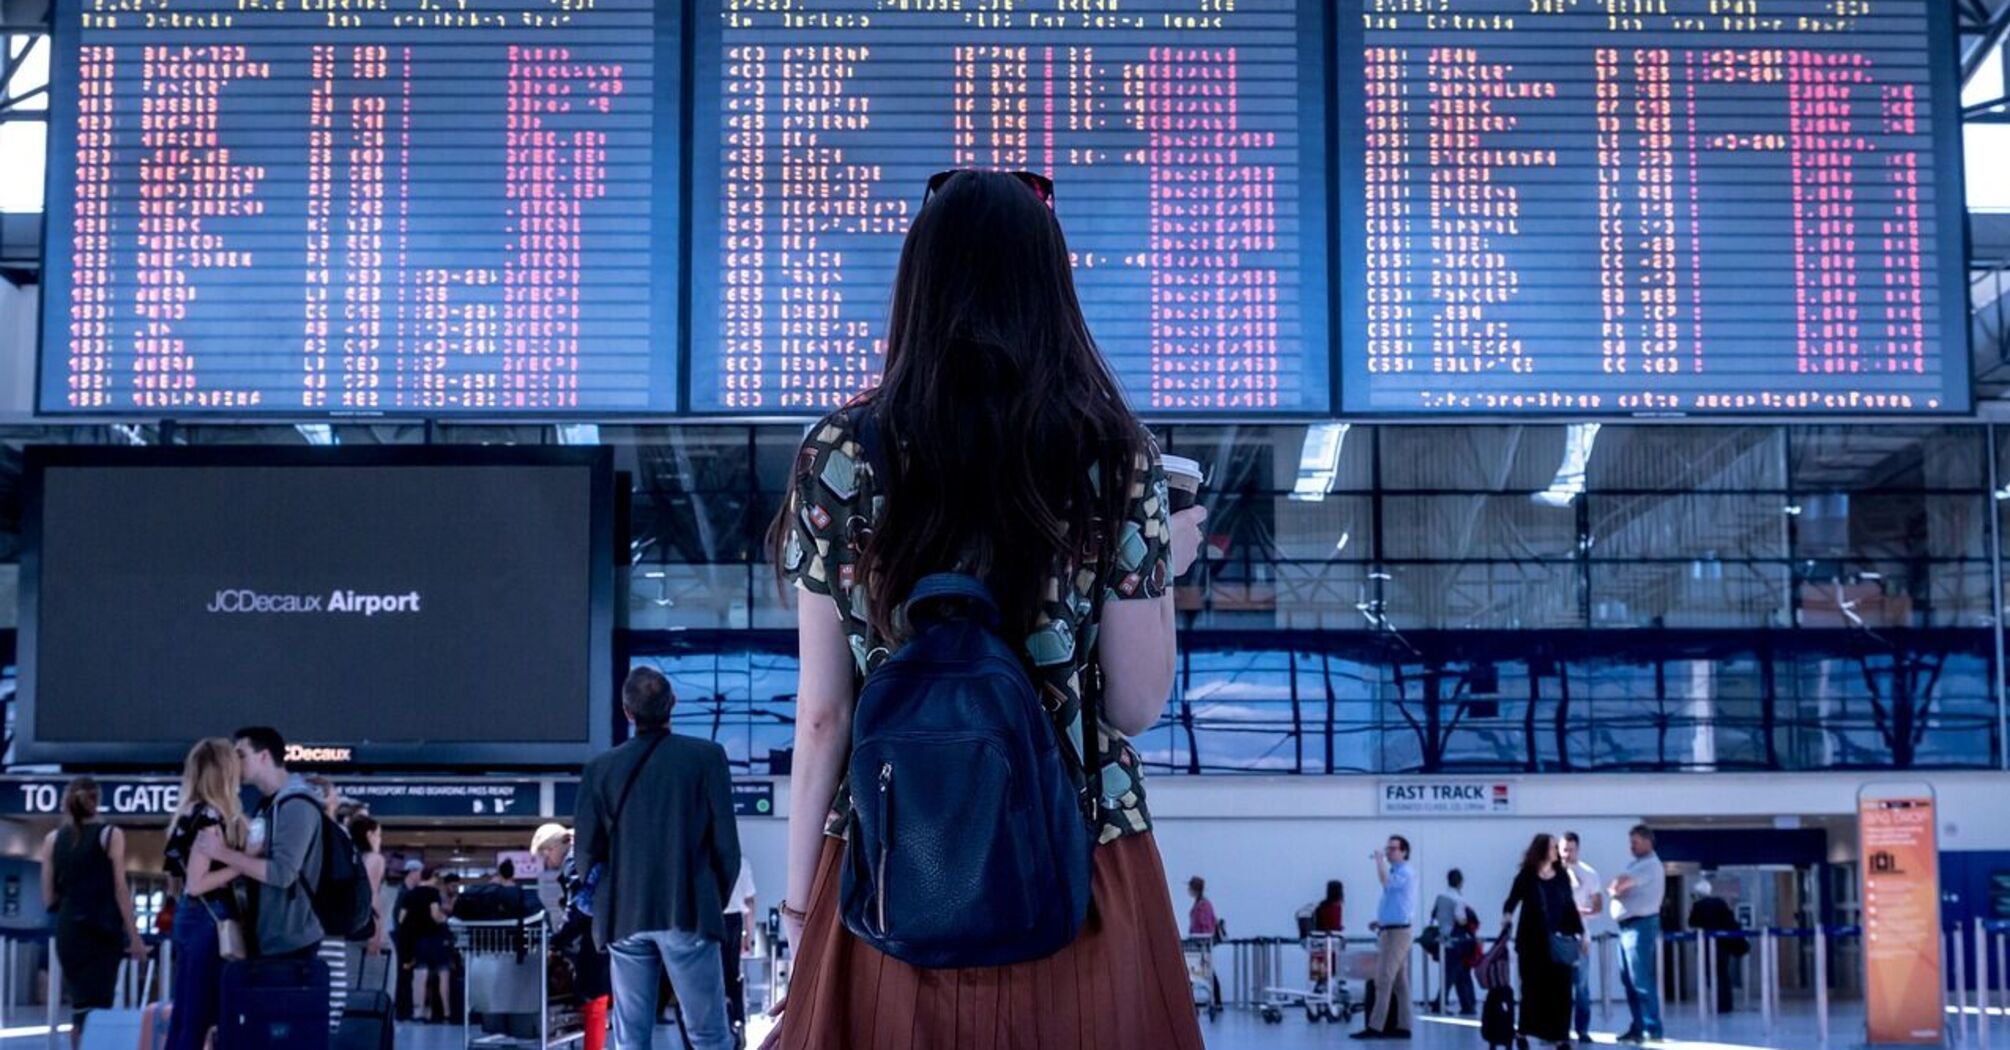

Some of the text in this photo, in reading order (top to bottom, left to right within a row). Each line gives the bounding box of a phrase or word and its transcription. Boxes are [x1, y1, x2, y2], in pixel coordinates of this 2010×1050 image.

[207, 589, 420, 616] JCDecaux Airport
[20, 784, 58, 812] TO
[1386, 785, 1484, 799] FAST TRACK
